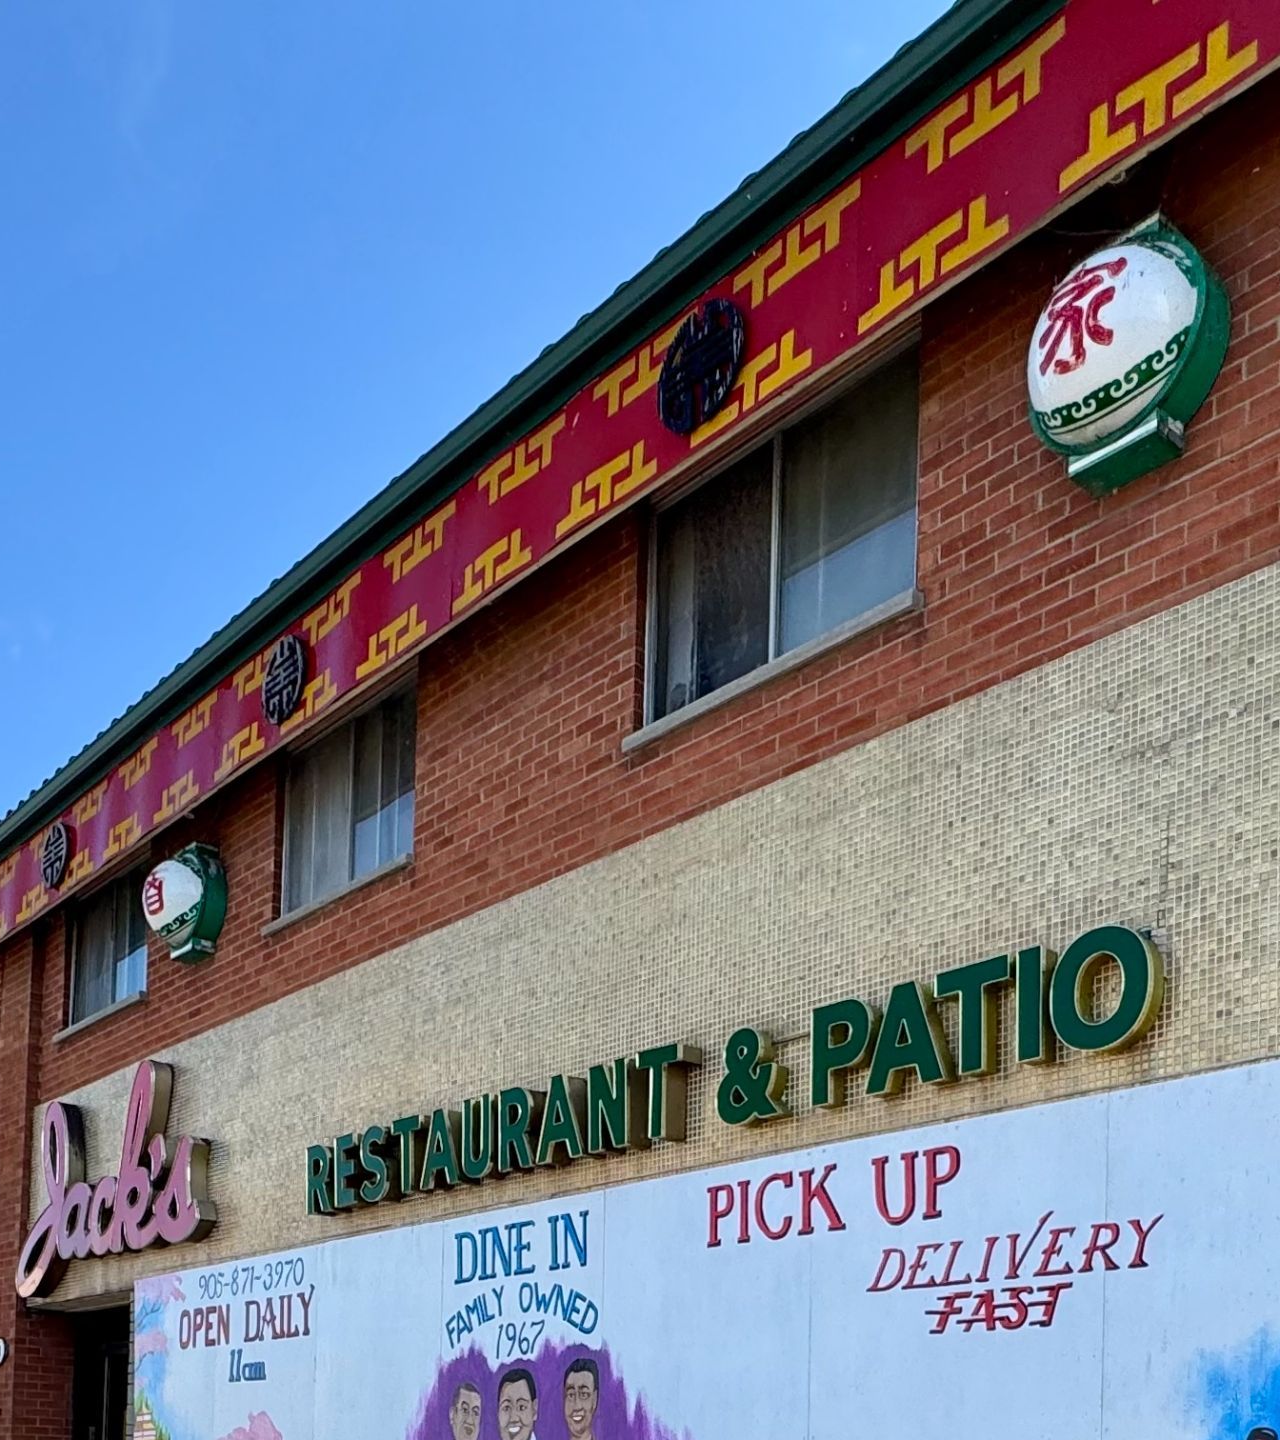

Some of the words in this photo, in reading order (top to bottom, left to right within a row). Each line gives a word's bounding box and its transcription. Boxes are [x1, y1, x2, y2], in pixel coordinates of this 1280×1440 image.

[306, 1043, 681, 1215] RESTAURANT
[716, 1026, 781, 1126] &
[810, 922, 1154, 1107] PATIO
[15, 1059, 202, 1298] Jack's
[706, 1163, 847, 1248] PICK
[871, 1144, 962, 1226] UP
[198, 1257, 305, 1300] 905-871-3970
[454, 1220, 536, 1285] DINE
[547, 1210, 590, 1272] IN
[865, 1210, 1165, 1293] DELIVERY
[179, 1303, 231, 1350] OPEN
[243, 1283, 315, 1343] DAILY
[445, 1285, 504, 1349] FAMILY
[519, 1281, 599, 1335] OWNED
[495, 1319, 546, 1360] 1967
[924, 1282, 1074, 1335] FAST
